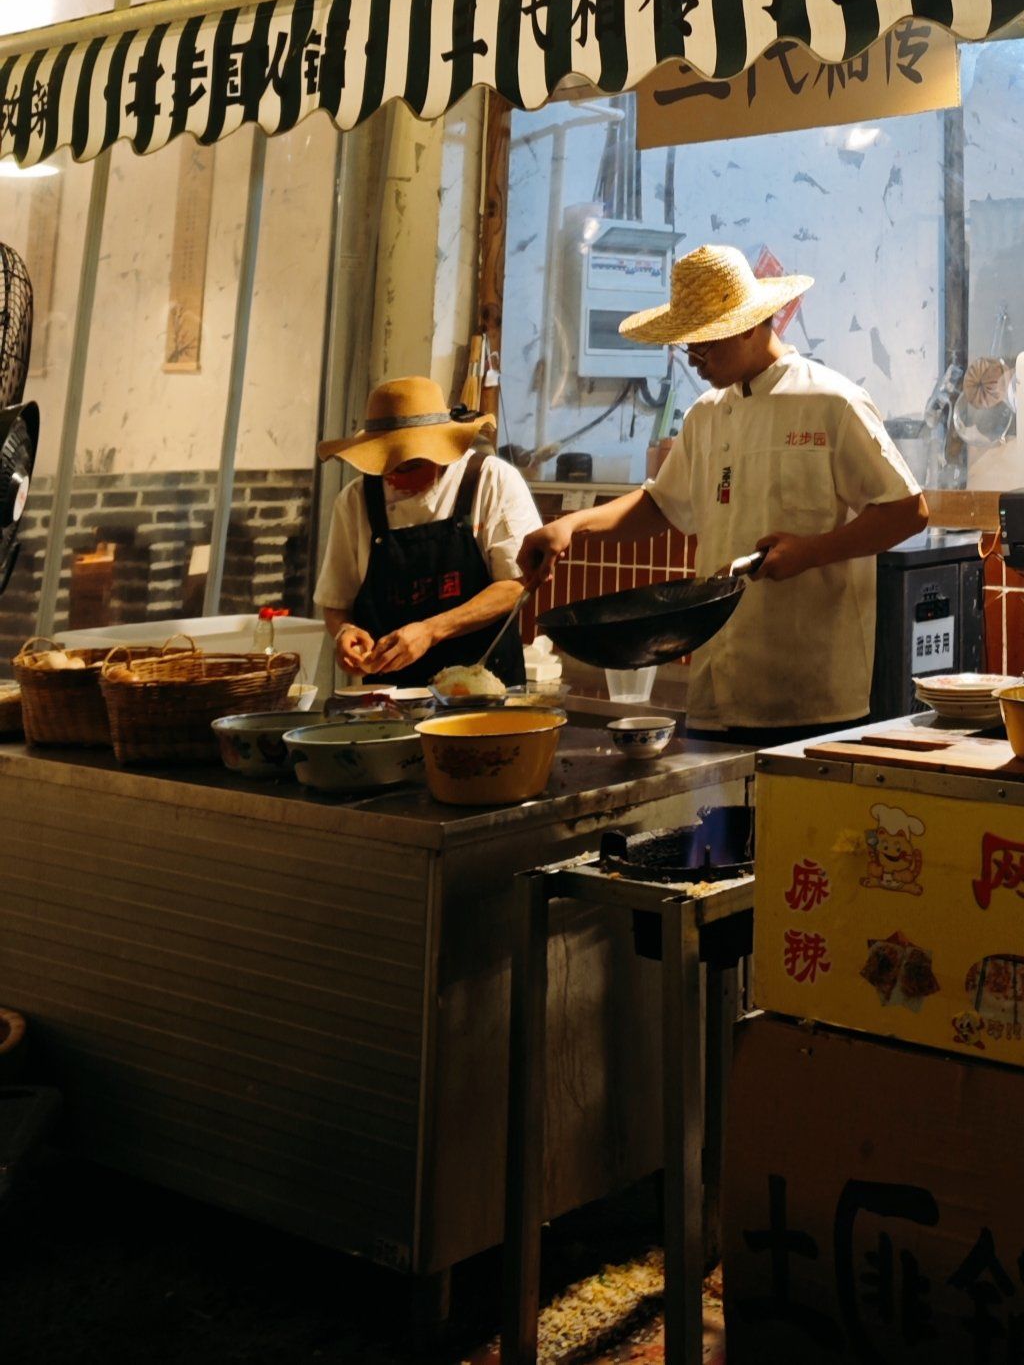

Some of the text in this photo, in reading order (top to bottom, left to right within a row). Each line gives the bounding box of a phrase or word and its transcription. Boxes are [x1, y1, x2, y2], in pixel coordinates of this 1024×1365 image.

[785, 431, 827, 447] 北步园
[783, 856, 832, 984] 麻辣
